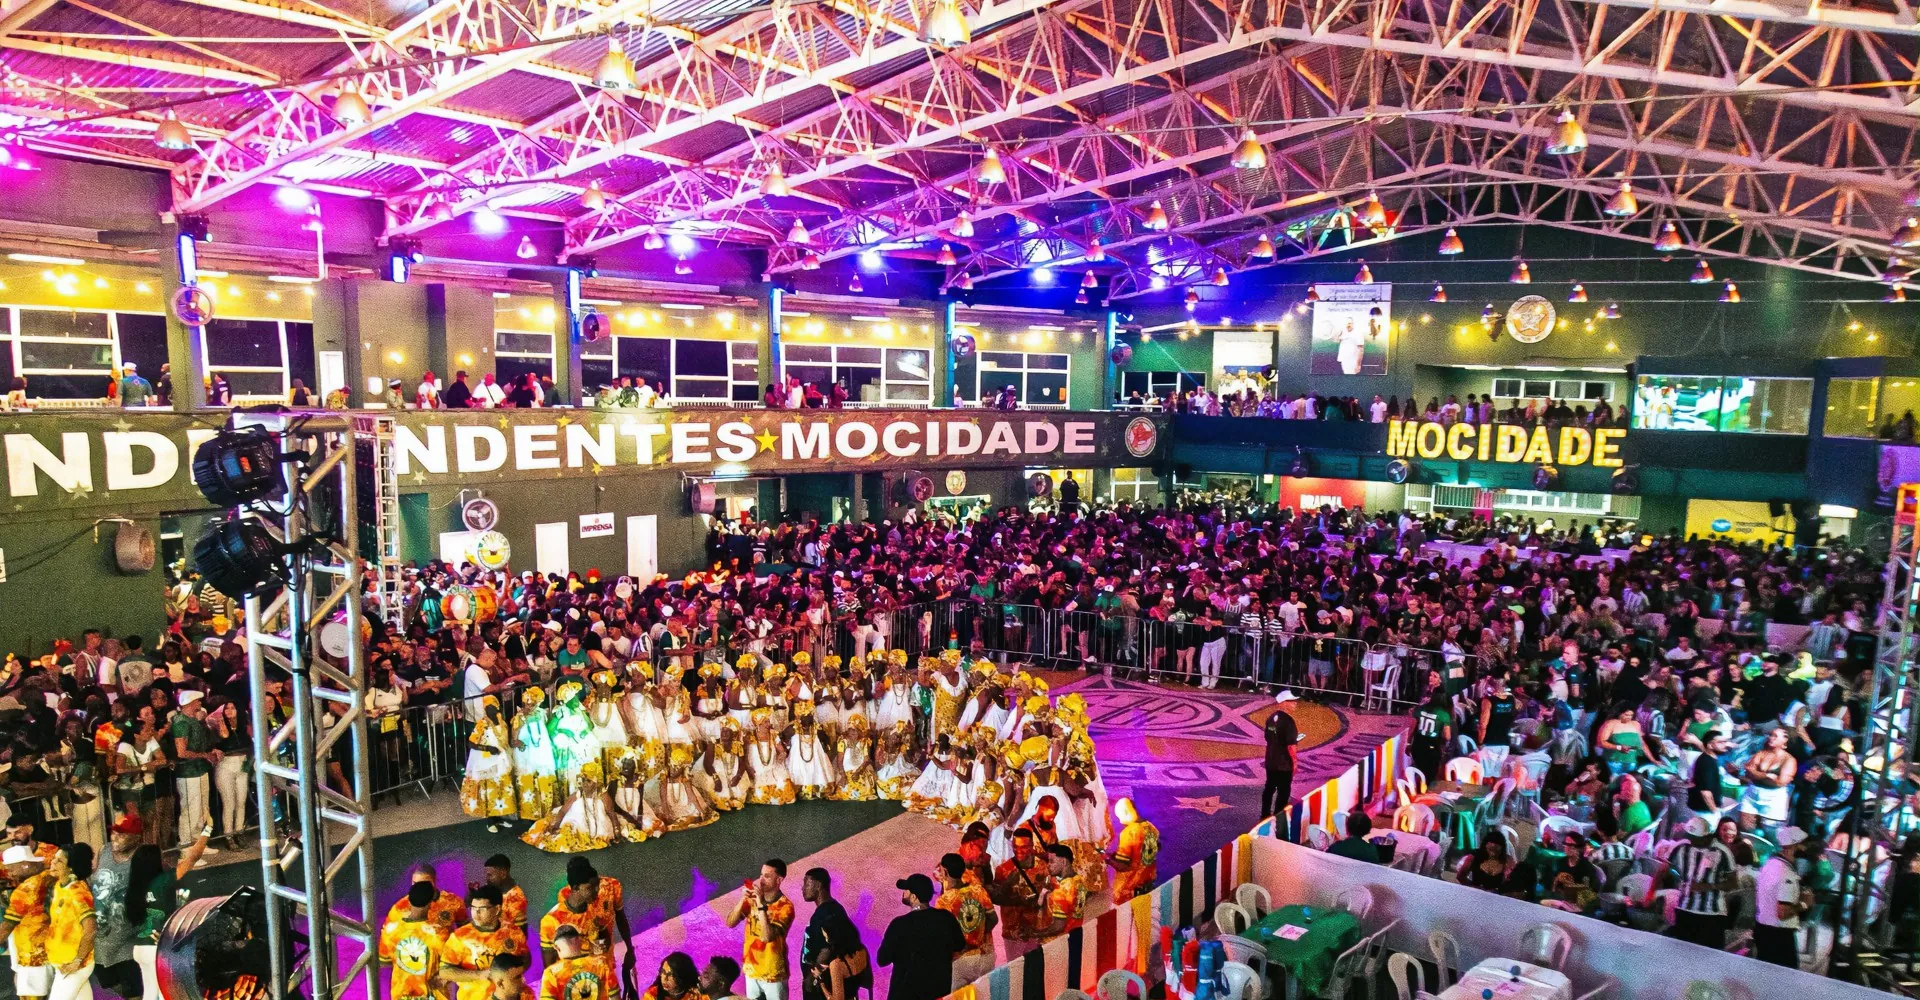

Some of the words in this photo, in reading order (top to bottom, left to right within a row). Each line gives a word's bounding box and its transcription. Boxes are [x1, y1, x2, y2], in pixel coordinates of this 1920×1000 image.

[781, 421, 1096, 460] MOCIDADE
[1386, 419, 1627, 467] MOCIDADE
[582, 523, 613, 533] IMPRENSA
